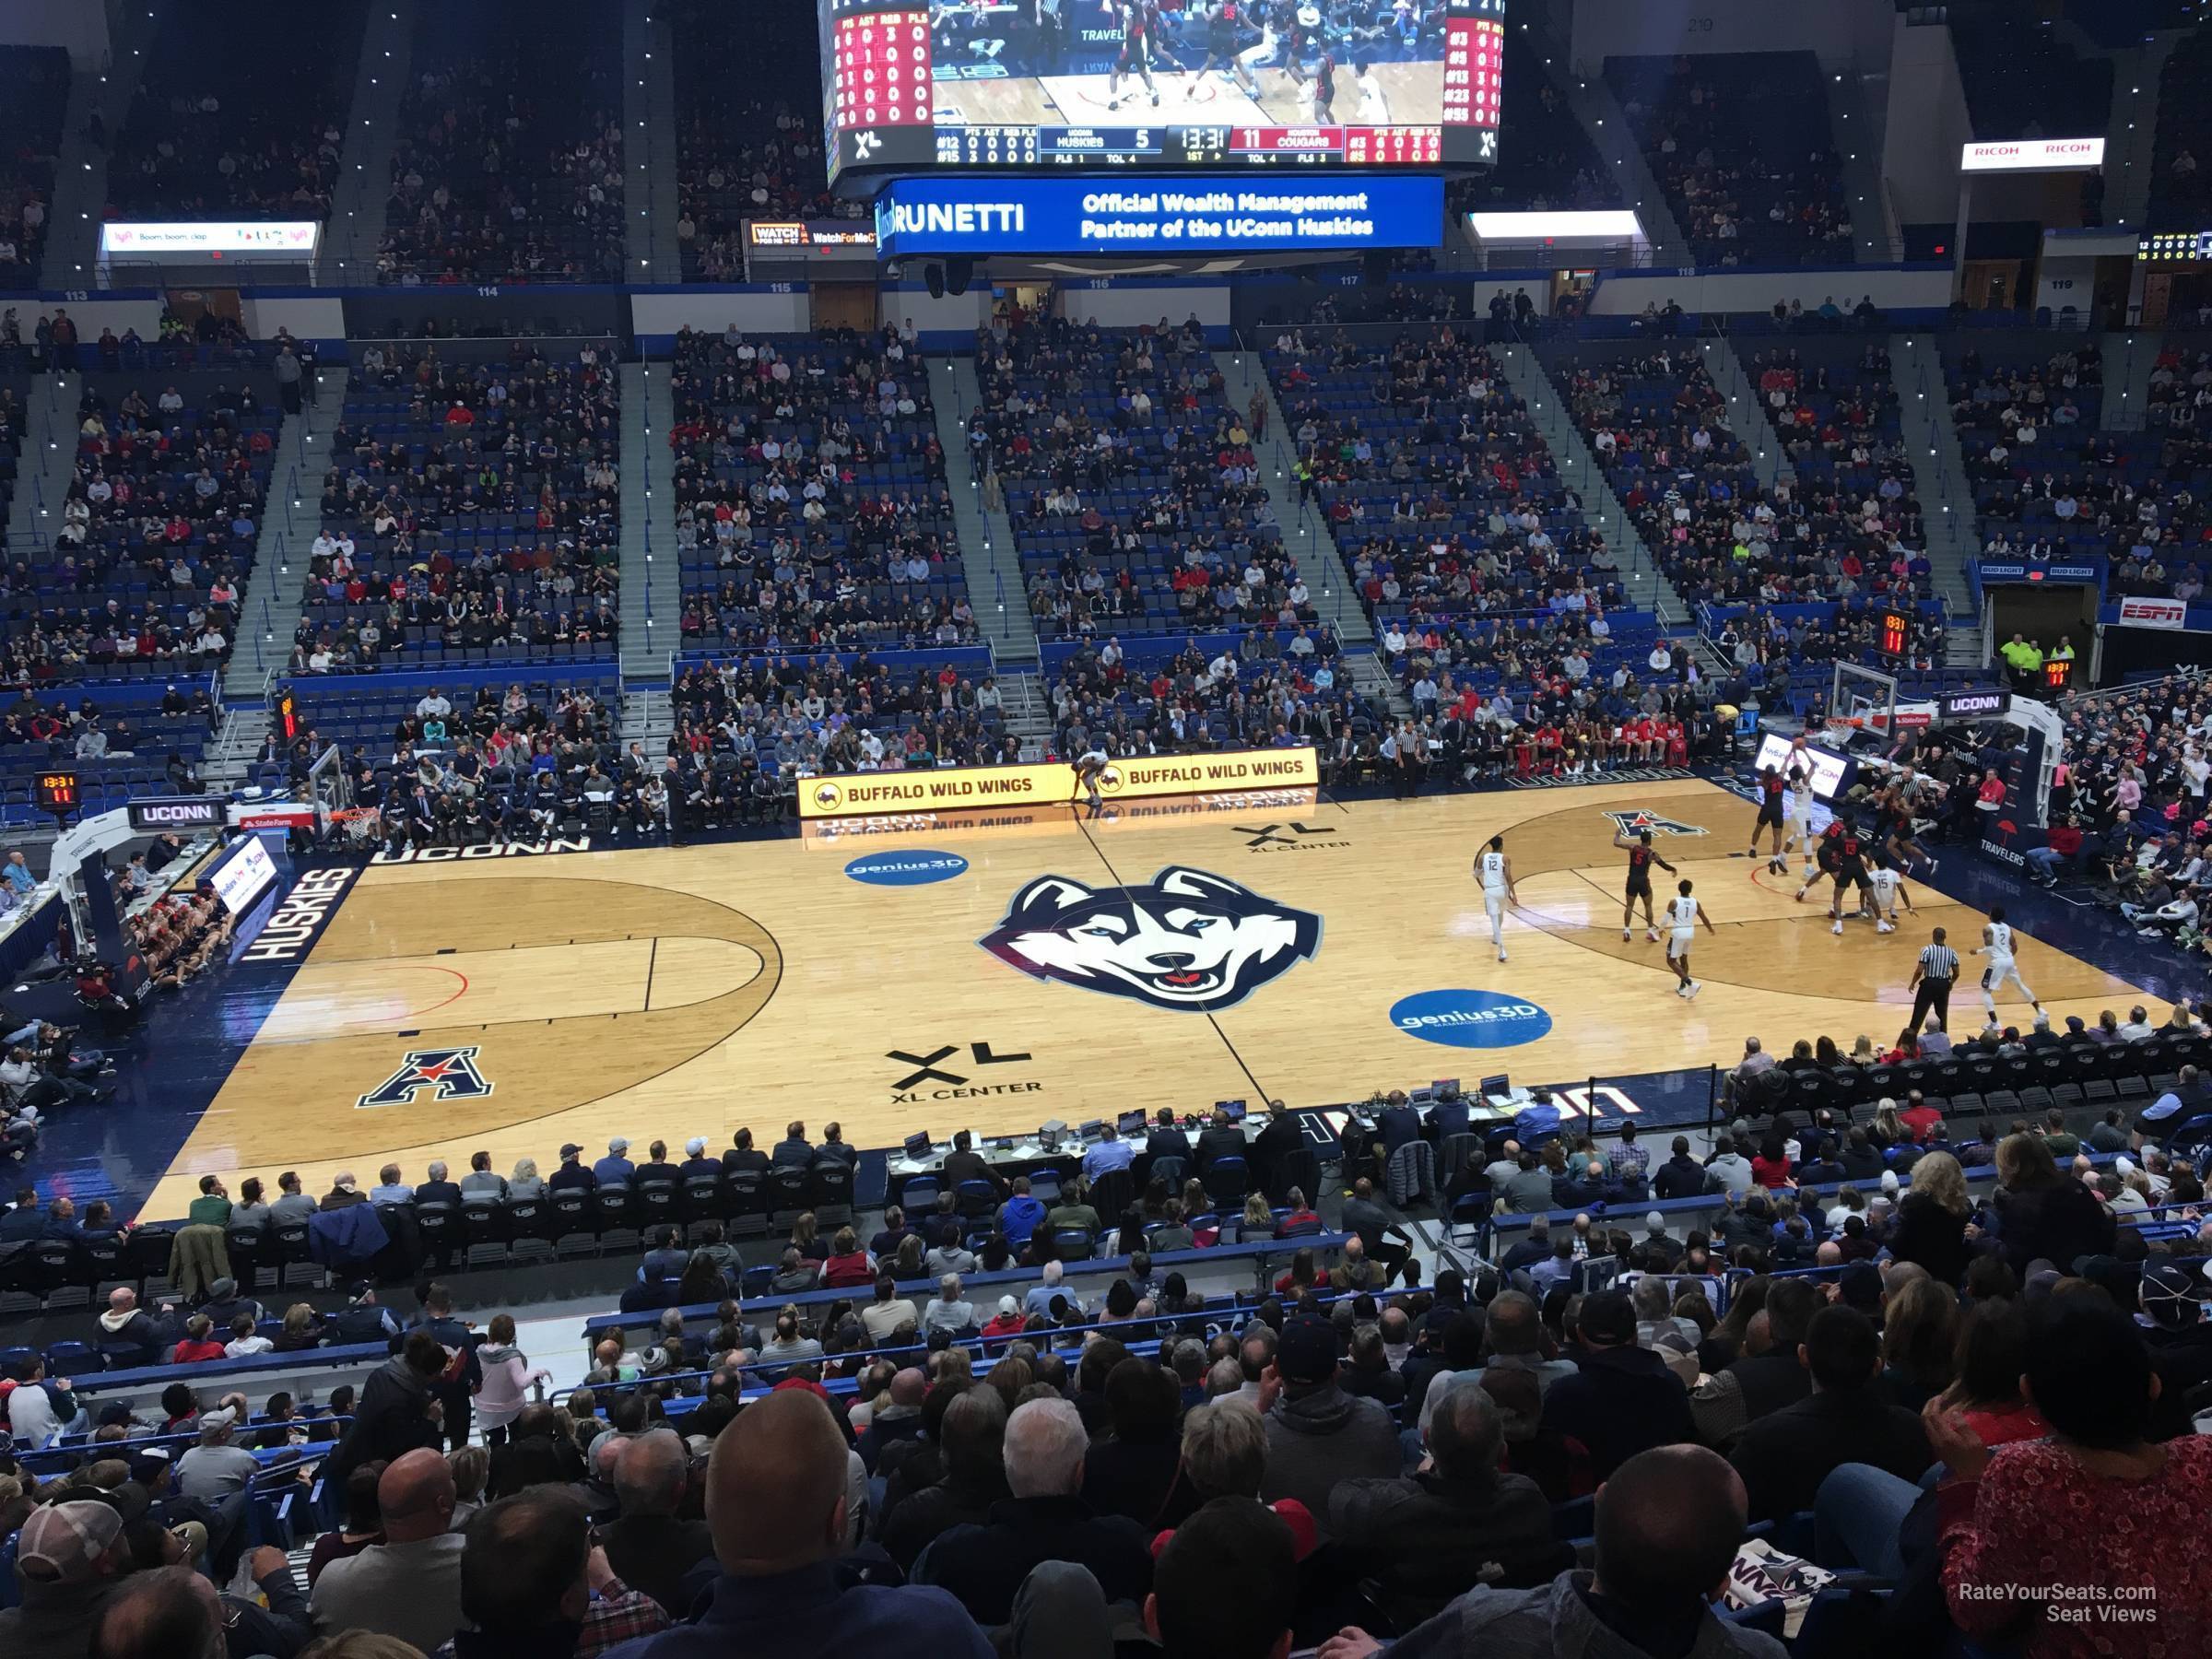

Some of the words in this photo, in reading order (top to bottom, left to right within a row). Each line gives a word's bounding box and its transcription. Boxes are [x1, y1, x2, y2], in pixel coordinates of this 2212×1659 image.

[859, 16, 875, 26] AST
[880, 14, 901, 24] REB
[909, 13, 927, 24] FLS
[887, 27, 896, 41] 3
[912, 26, 924, 41] 0
[1081, 29, 1124, 41] TRAVEL
[1450, 32, 1468, 46] #3
[887, 47, 898, 62] 0
[913, 46, 925, 61] 0
[1449, 51, 1467, 65] #5
[887, 67, 899, 81] 0
[914, 66, 926, 80] 0
[1445, 70, 1469, 84] #13
[888, 87, 900, 101] 0
[914, 86, 926, 100] 0
[1444, 88, 1469, 103] #23
[888, 106, 900, 121] 0
[915, 106, 927, 121] 0
[936, 137, 959, 149] #12
[968, 136, 978, 149] 0
[987, 136, 997, 149] 0
[1006, 136, 1017, 149] 0
[1024, 136, 1034, 149] 0
[1056, 137, 1104, 148] HUSKIES
[1135, 130, 1149, 148] 5
[1182, 131, 1224, 148] 13:31
[1243, 129, 1260, 148] 11
[1277, 136, 1329, 148] COUGARS
[1349, 137, 1366, 148] #3
[1394, 137, 1404, 148] 0
[1429, 137, 1439, 148] 0
[1975, 147, 2018, 156] RICOH
[2045, 144, 2090, 154] RICOH
[937, 151, 959, 162] #15
[969, 151, 978, 162] 3
[987, 151, 998, 162] 0
[1007, 151, 1018, 162] 0
[1025, 151, 1034, 162] 0
[1055, 154, 1072, 163] FLS
[1078, 154, 1084, 163] 1
[1107, 154, 1124, 163] TOL
[1129, 154, 1136, 163] 4
[1187, 151, 1203, 161] 1ST
[1247, 153, 1265, 163] TOL
[1269, 153, 1277, 163] 4
[1298, 153, 1314, 163] FLS
[1320, 153, 1326, 163] 3
[1349, 150, 1366, 162] #5
[1375, 150, 1385, 162] 0
[1395, 150, 1402, 162] 1
[1412, 150, 1421, 162] 0
[1429, 150, 1439, 162] 0
[1082, 194, 1157, 213] Official
[1161, 194, 1234, 212] Wealth
[1238, 192, 1368, 214] Management
[756, 228, 799, 238] WATCH
[1081, 220, 1157, 238] Partner
[1161, 218, 1183, 238] of
[1187, 219, 1221, 238] the
[1226, 219, 1292, 237] UConn
[1298, 217, 1373, 236] Huskies
[2139, 241, 2149, 250] 12
[2165, 241, 2172, 249] 0
[2177, 241, 2184, 249] 0
[2176, 251, 2183, 259] 0
[2188, 251, 2195, 259] 0
[1677, 267, 1695, 276] 118
[770, 282, 791, 293] 115
[1089, 279, 1109, 290] 116
[1340, 276, 1358, 286] 117
[65, 289, 88, 302] 113
[477, 286, 499, 298] 114
[2051, 567, 2070, 575] BUD
[2071, 568, 2093, 576] LIGHT
[2123, 604, 2183, 620] ESPN
[1886, 615, 1905, 631] 13:31
[1888, 631, 1901, 653] 11
[2047, 663, 2069, 673] 13:31
[2052, 673, 2065, 685] 11
[1950, 696, 1999, 712] UCONN
[1953, 746, 1979, 766] Hartfor
[1130, 767, 1202, 784] BUFFALO
[1206, 764, 1248, 779] WILD
[1252, 759, 1304, 775] WINGS
[1505, 767, 1697, 789] UCONN
[43, 776, 74, 788] 13:31
[53, 789, 68, 802] 11
[848, 784, 924, 802] BUFFALO
[930, 782, 973, 797] WILD
[978, 778, 1032, 794] WINGS
[1198, 789, 1314, 804] UCONN
[1218, 797, 1307, 808] HEALTH
[2071, 787, 2097, 812] XL
[143, 805, 212, 821] UCONN
[817, 814, 937, 829] UCONN
[832, 823, 926, 834] HEALTH
[1231, 822, 1336, 847] XL
[369, 838, 590, 865] UCONN
[1277, 841, 1352, 853] CENTER
[1981, 839, 2026, 867] TRAVELERS
[1636, 853, 1643, 865] 5
[843, 859, 964, 875] genius3D
[1488, 861, 1498, 871] 12
[1877, 878, 1888, 888] 15
[241, 866, 354, 962] HUSKIES
[1686, 907, 1690, 918] 1
[1998, 934, 2006, 947] 2
[1396, 1006, 1538, 1030] genius3D
[1434, 1018, 1509, 1028] MAMMOGRAPHY
[884, 1041, 1032, 1091] XL
[890, 1093, 926, 1104] XL
[932, 1082, 1043, 1100] CENTER
